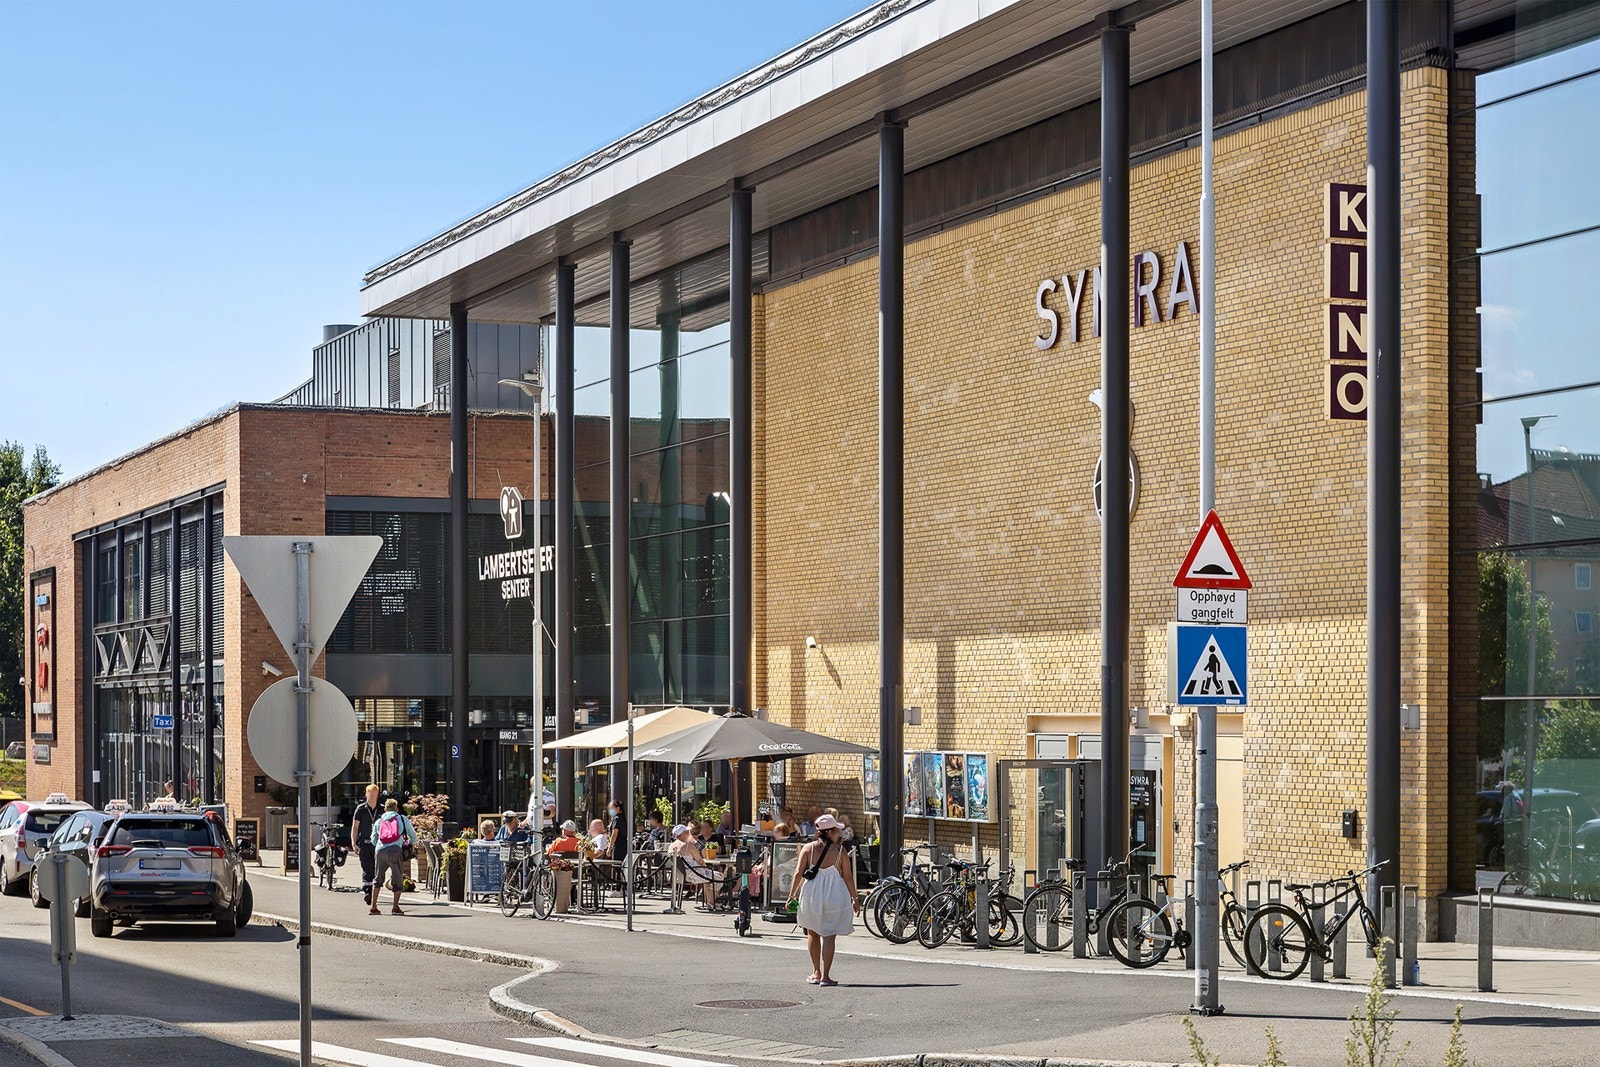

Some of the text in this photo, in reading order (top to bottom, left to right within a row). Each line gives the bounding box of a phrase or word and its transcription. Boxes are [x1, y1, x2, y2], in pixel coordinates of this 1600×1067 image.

[1336, 190, 1368, 414] KINO
[478, 545, 554, 581] LAMBERTSEER
[501, 578, 531, 600] SENTER
[1190, 590, 1236, 604] Opphøyd
[1191, 608, 1234, 620] gangfelt
[154, 717, 173, 727] Taxi
[511, 731, 518, 740] 21
[1130, 775, 1150, 786] SYMRA
